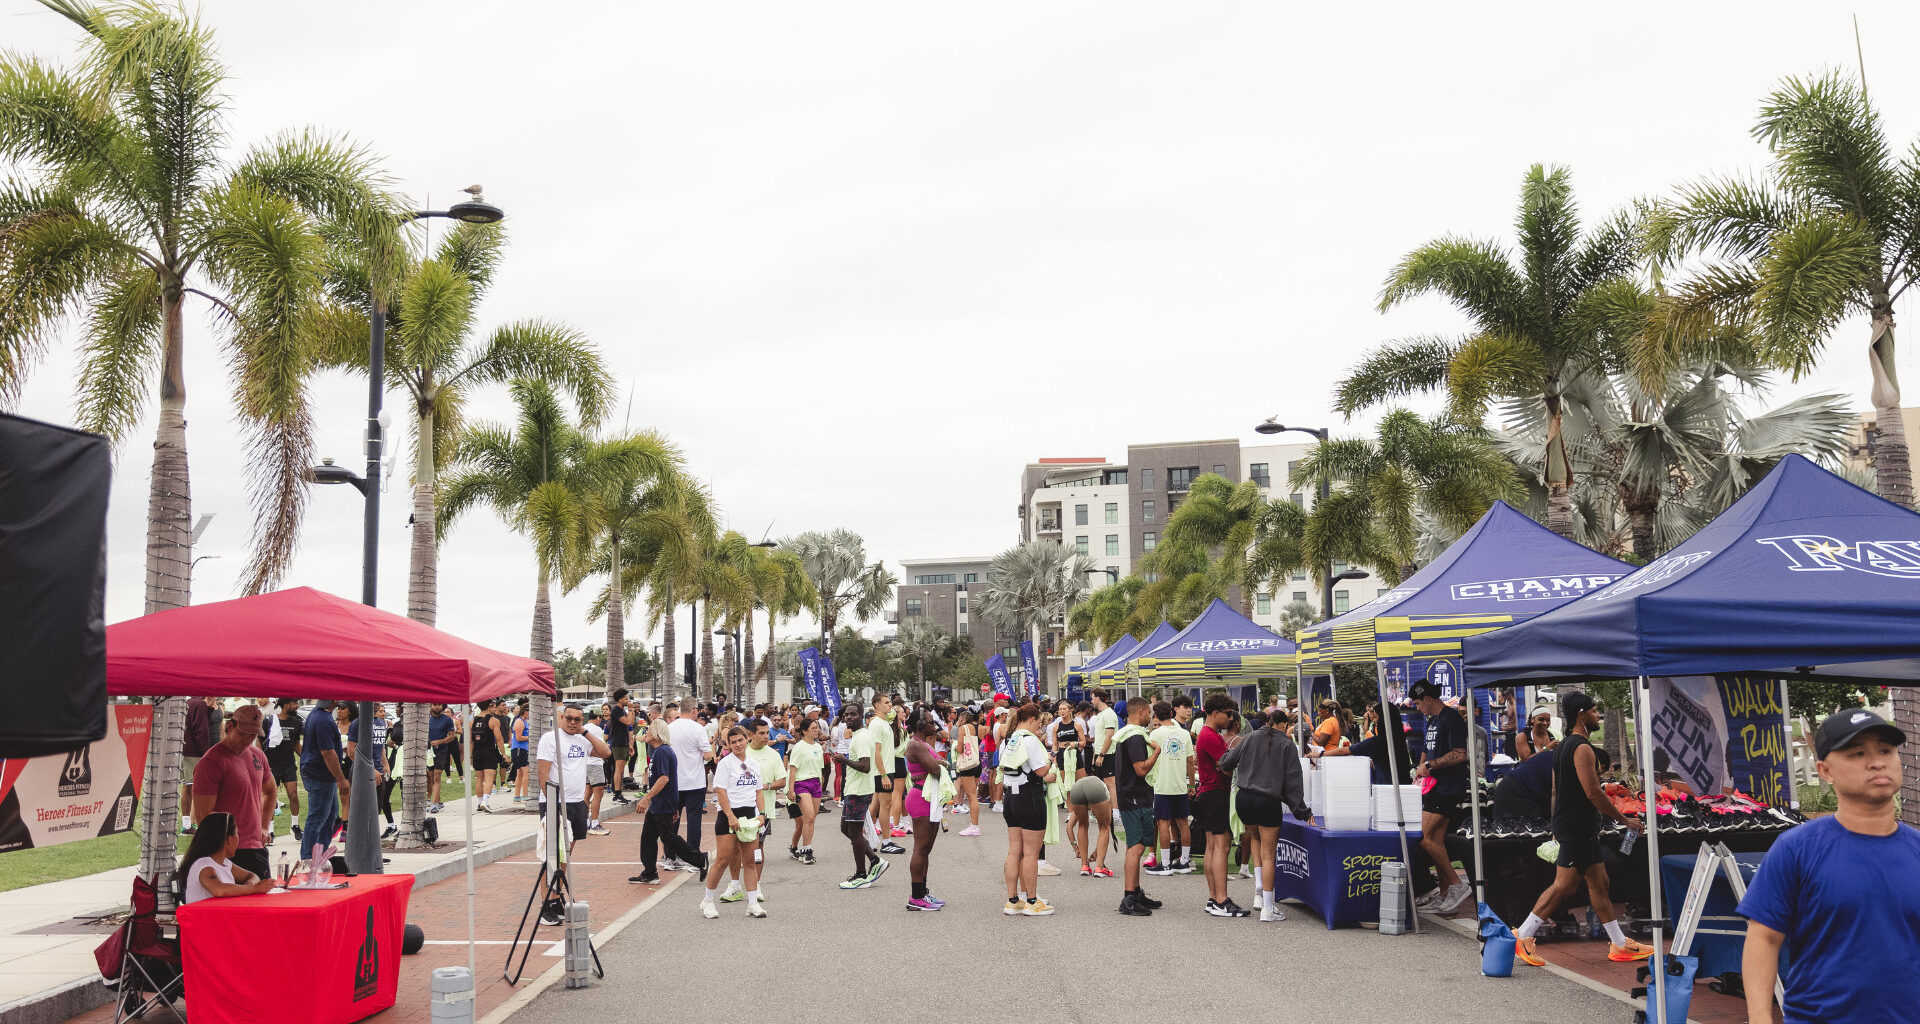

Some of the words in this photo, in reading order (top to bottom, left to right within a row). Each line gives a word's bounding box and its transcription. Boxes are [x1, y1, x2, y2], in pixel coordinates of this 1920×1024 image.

[1459, 576, 1627, 597] CHAMP
[1186, 640, 1275, 650] CHAMPS
[1434, 673, 1449, 685] RUN
[1662, 700, 1713, 763] RUN
[1651, 713, 1714, 795] CLUB
[36, 808, 66, 821] Heroes
[66, 804, 92, 818] Fitness
[92, 800, 104, 814] PT
[1276, 842, 1308, 871] CHAMPS
[1347, 883, 1380, 898] LIFE
